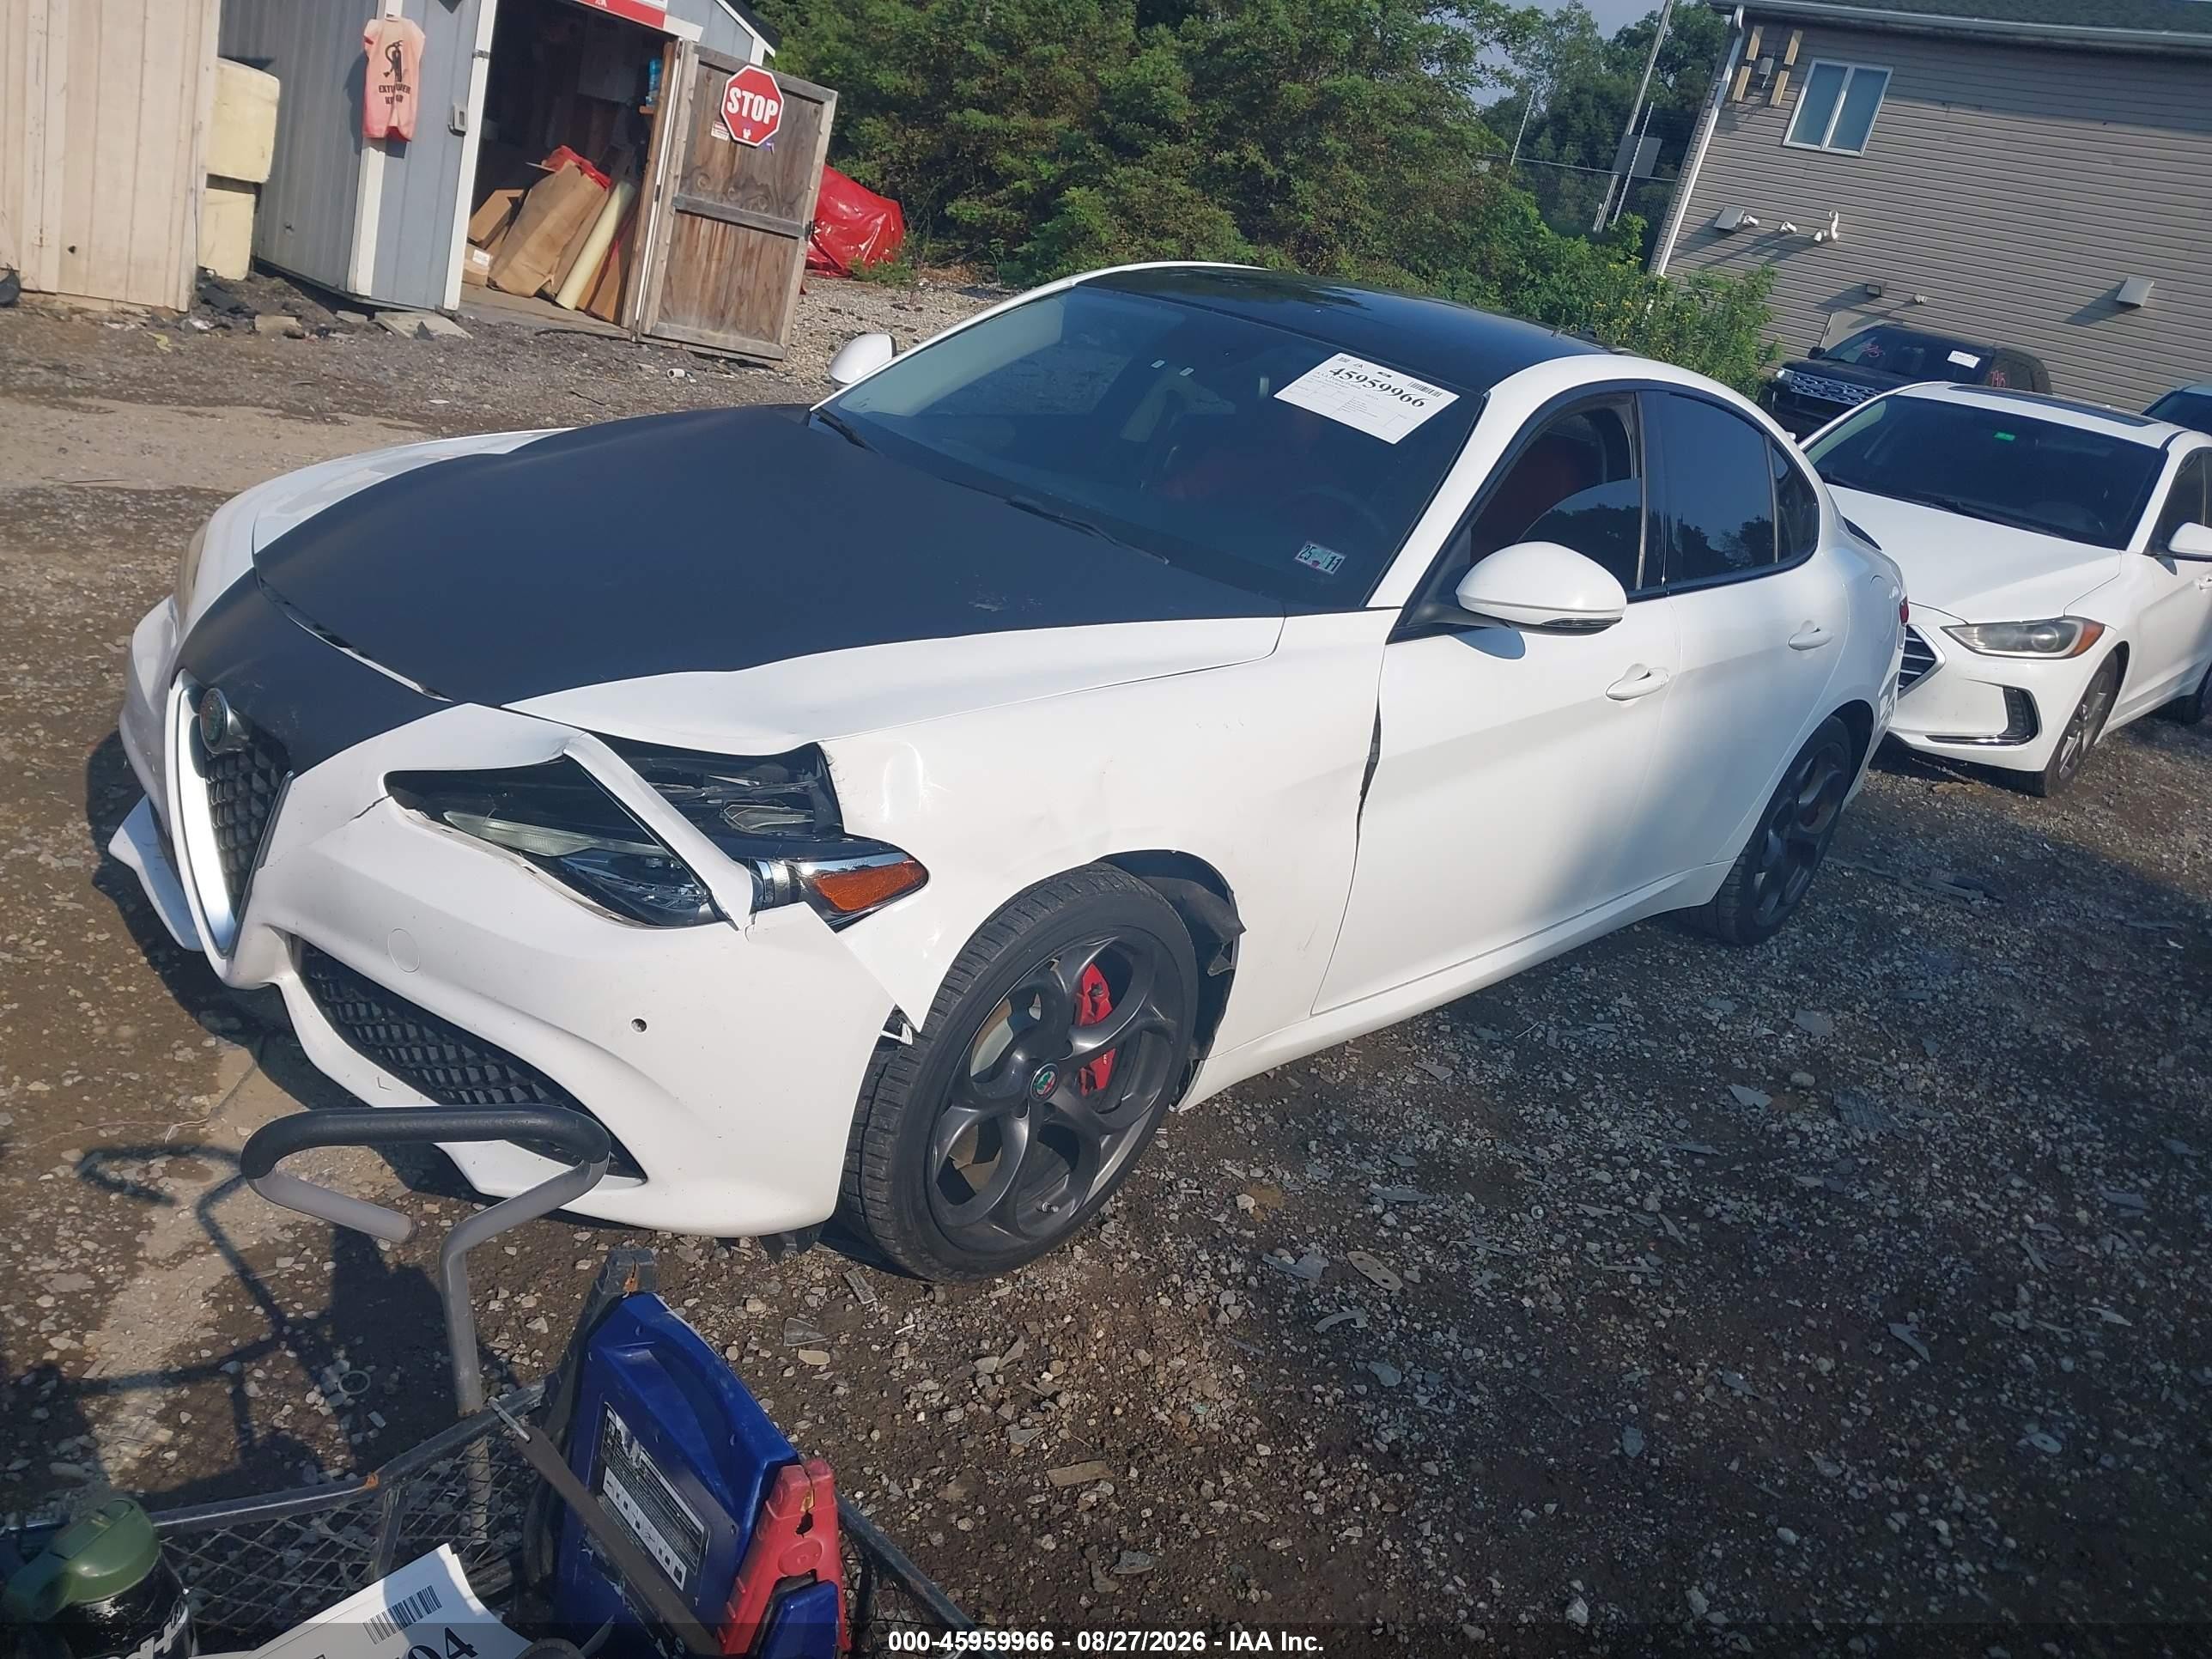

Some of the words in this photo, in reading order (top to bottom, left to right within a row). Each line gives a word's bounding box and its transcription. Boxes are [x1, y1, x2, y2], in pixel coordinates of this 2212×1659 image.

[726, 87, 779, 125] STOP
[1329, 368, 1429, 407] 45959966
[1297, 544, 1317, 561] 25
